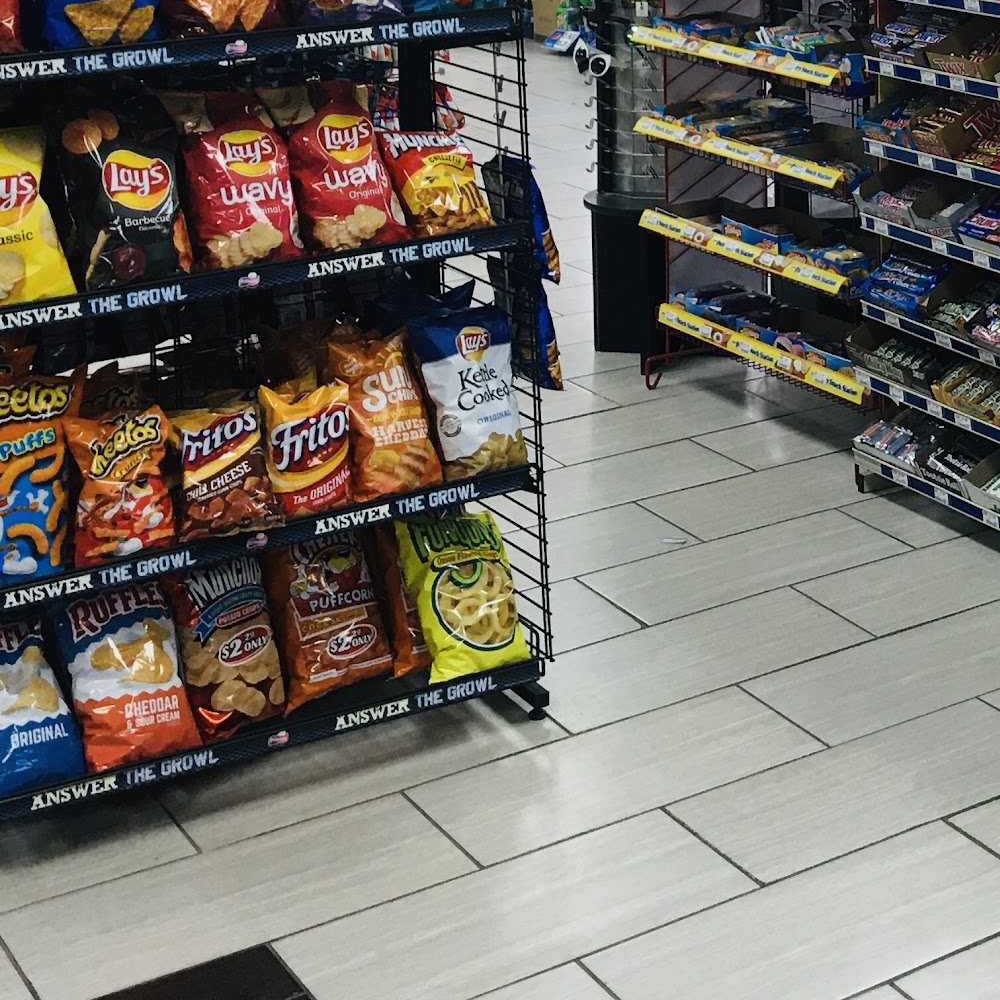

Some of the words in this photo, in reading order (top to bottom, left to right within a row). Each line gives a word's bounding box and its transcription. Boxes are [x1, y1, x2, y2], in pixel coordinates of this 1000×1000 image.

[296, 27, 375, 49] ANSWER
[379, 23, 408, 39] THE
[412, 17, 465, 36] GROWL
[0, 59, 67, 79] NSWER
[72, 56, 109, 72] THE
[112, 48, 175, 67] GROWL
[323, 122, 370, 150] Lay's
[223, 137, 273, 165] Lay's
[109, 163, 164, 196] Lay's
[324, 160, 388, 190] wavy
[219, 178, 293, 206] wavy
[349, 187, 383, 199] Original
[124, 215, 171, 227] Barbecue
[307, 252, 385, 278] ANSWER
[389, 246, 419, 263] THE
[422, 237, 475, 258] GROWL
[88, 294, 122, 314] THE
[127, 284, 188, 308] GROWL
[458, 332, 488, 353] Lay's
[362, 365, 412, 412] SUN
[458, 366, 497, 391] Kettle
[0, 382, 69, 418] eetos
[457, 383, 511, 411] Cooked
[477, 410, 511, 424] ORIGINAL
[2, 428, 56, 461] Puffs
[183, 410, 257, 463] Fritos
[210, 460, 252, 491] CHEESE
[293, 495, 307, 504] The
[314, 504, 391, 534] ANSWER
[396, 498, 425, 514] THE
[429, 483, 480, 508] GROWL
[3, 575, 94, 609] ANSWER
[98, 565, 133, 585] THE
[137, 550, 197, 578] GROWL
[185, 558, 262, 608] MUNCHO
[310, 589, 374, 612] PUFFCORN
[221, 637, 243, 659] $2
[243, 636, 268, 651] ONLY
[330, 634, 350, 654] $2
[351, 633, 374, 649] ONLY
[124, 695, 179, 717] CHEDDAR
[335, 699, 410, 731] ANSWER
[415, 694, 443, 709] THE
[447, 677, 497, 700] GROWL
[135, 715, 154, 728] SOUR
[156, 712, 180, 724] CREAM
[11, 723, 68, 748] ORIGINAL
[31, 776, 118, 811] ANSWER
[126, 765, 156, 784] THE
[160, 750, 219, 776] GROWL
